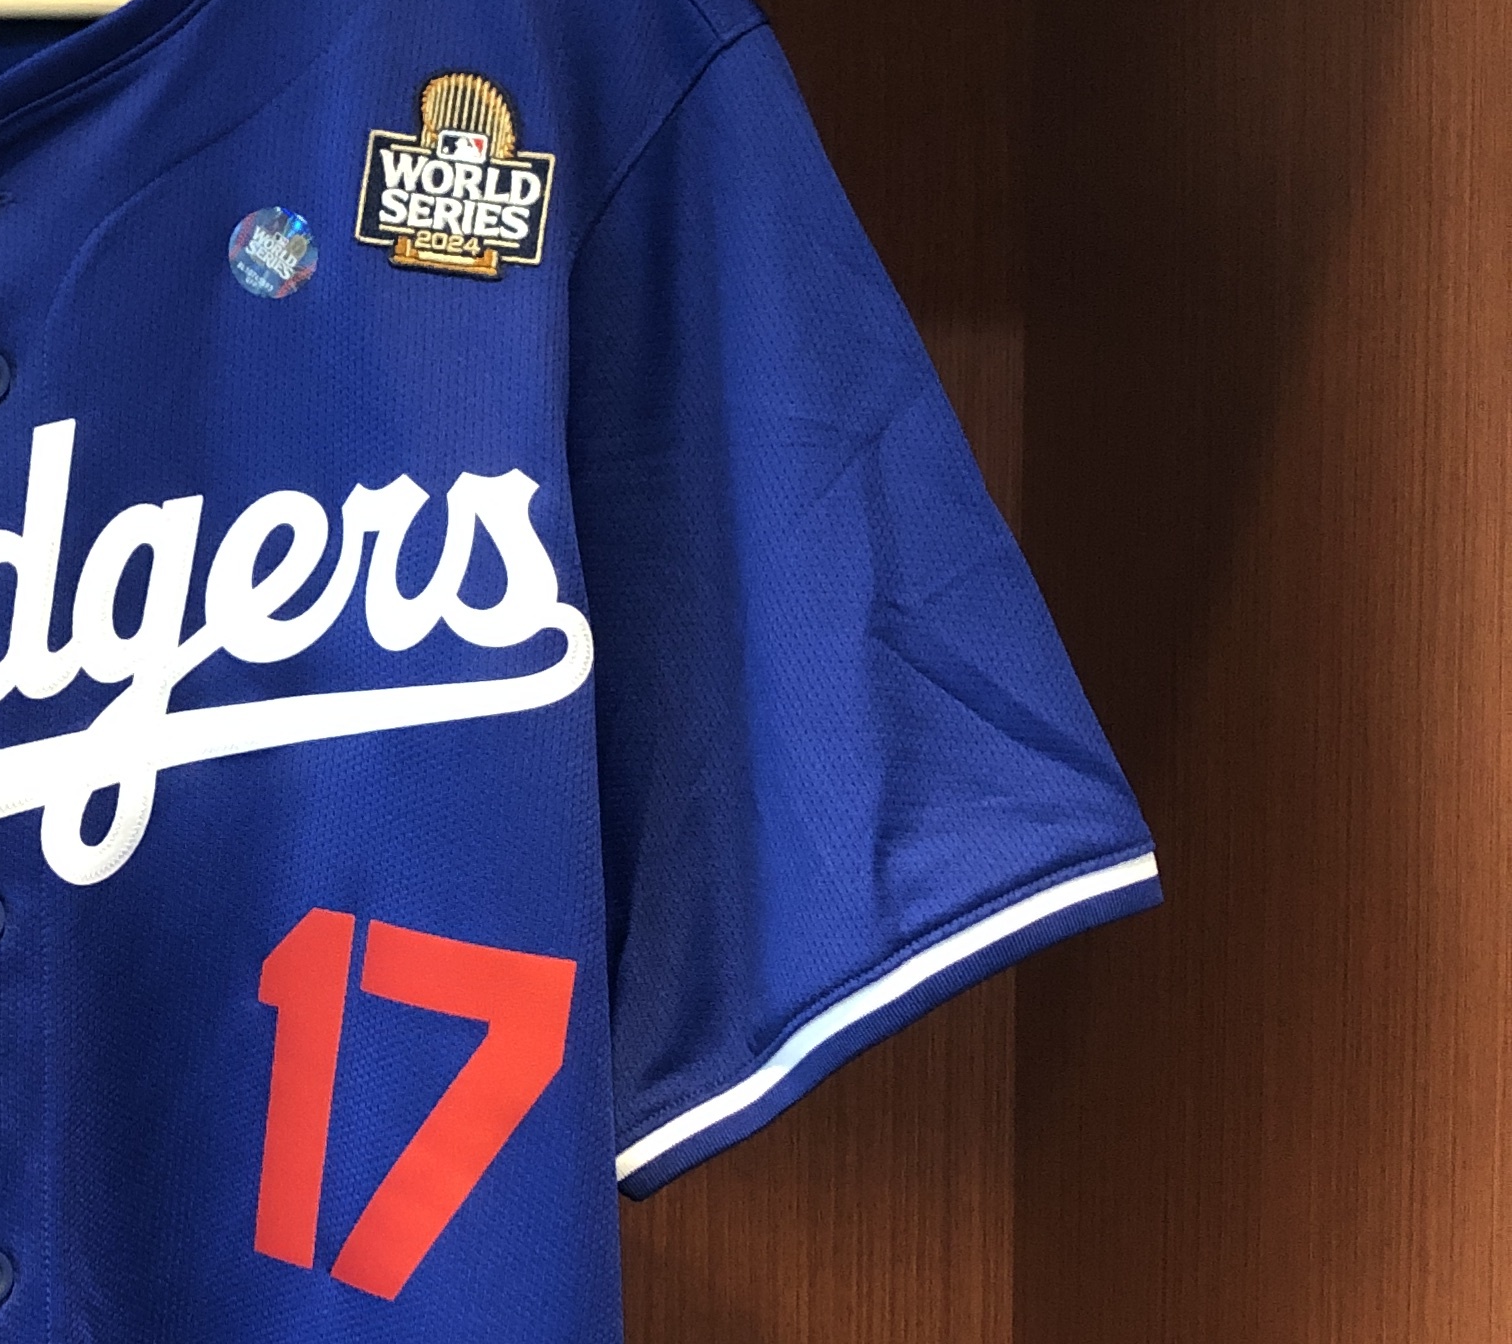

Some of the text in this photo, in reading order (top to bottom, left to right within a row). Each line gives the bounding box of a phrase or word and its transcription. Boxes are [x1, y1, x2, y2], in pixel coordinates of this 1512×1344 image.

[379, 148, 542, 207] WORLD
[378, 188, 531, 241] SERIES
[245, 239, 295, 280] SERIES
[253, 225, 298, 268] WORLD
[414, 230, 481, 256] 2024
[254, 907, 577, 1302] 17
